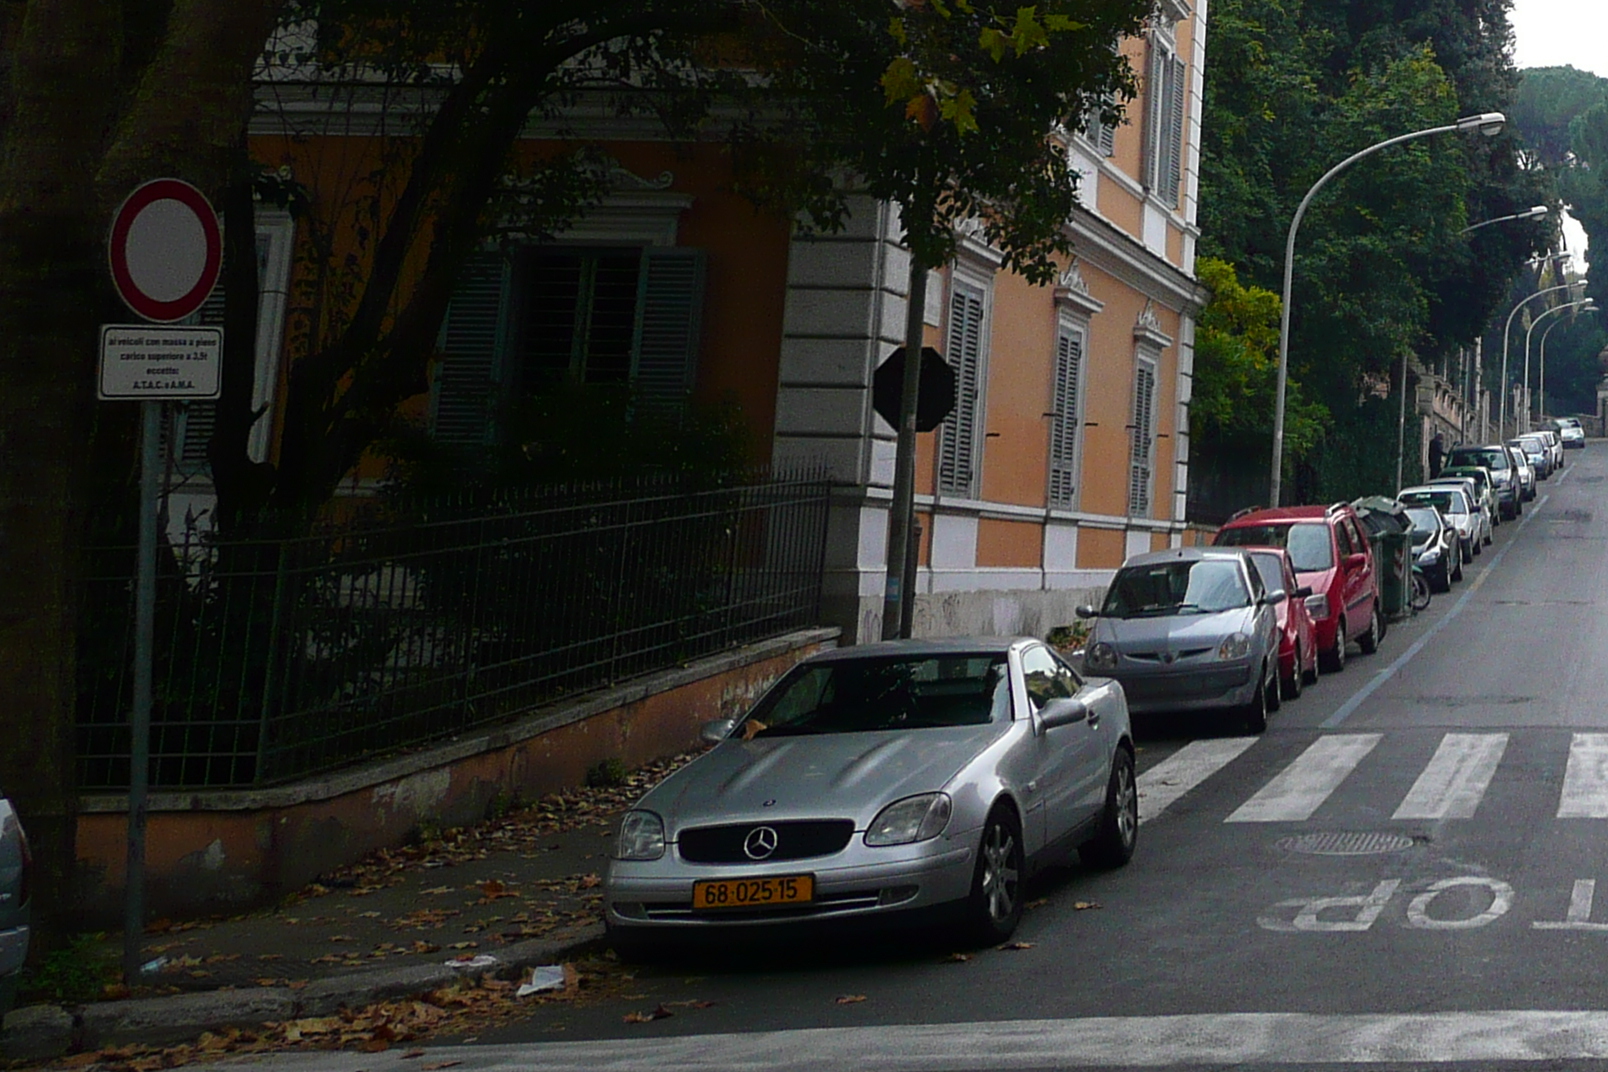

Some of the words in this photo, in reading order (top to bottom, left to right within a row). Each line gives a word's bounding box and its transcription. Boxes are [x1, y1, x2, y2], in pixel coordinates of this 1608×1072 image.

[118, 337, 144, 346] veicoli
[196, 338, 217, 347] pieno
[120, 352, 145, 360] carico
[148, 352, 184, 362] superiore
